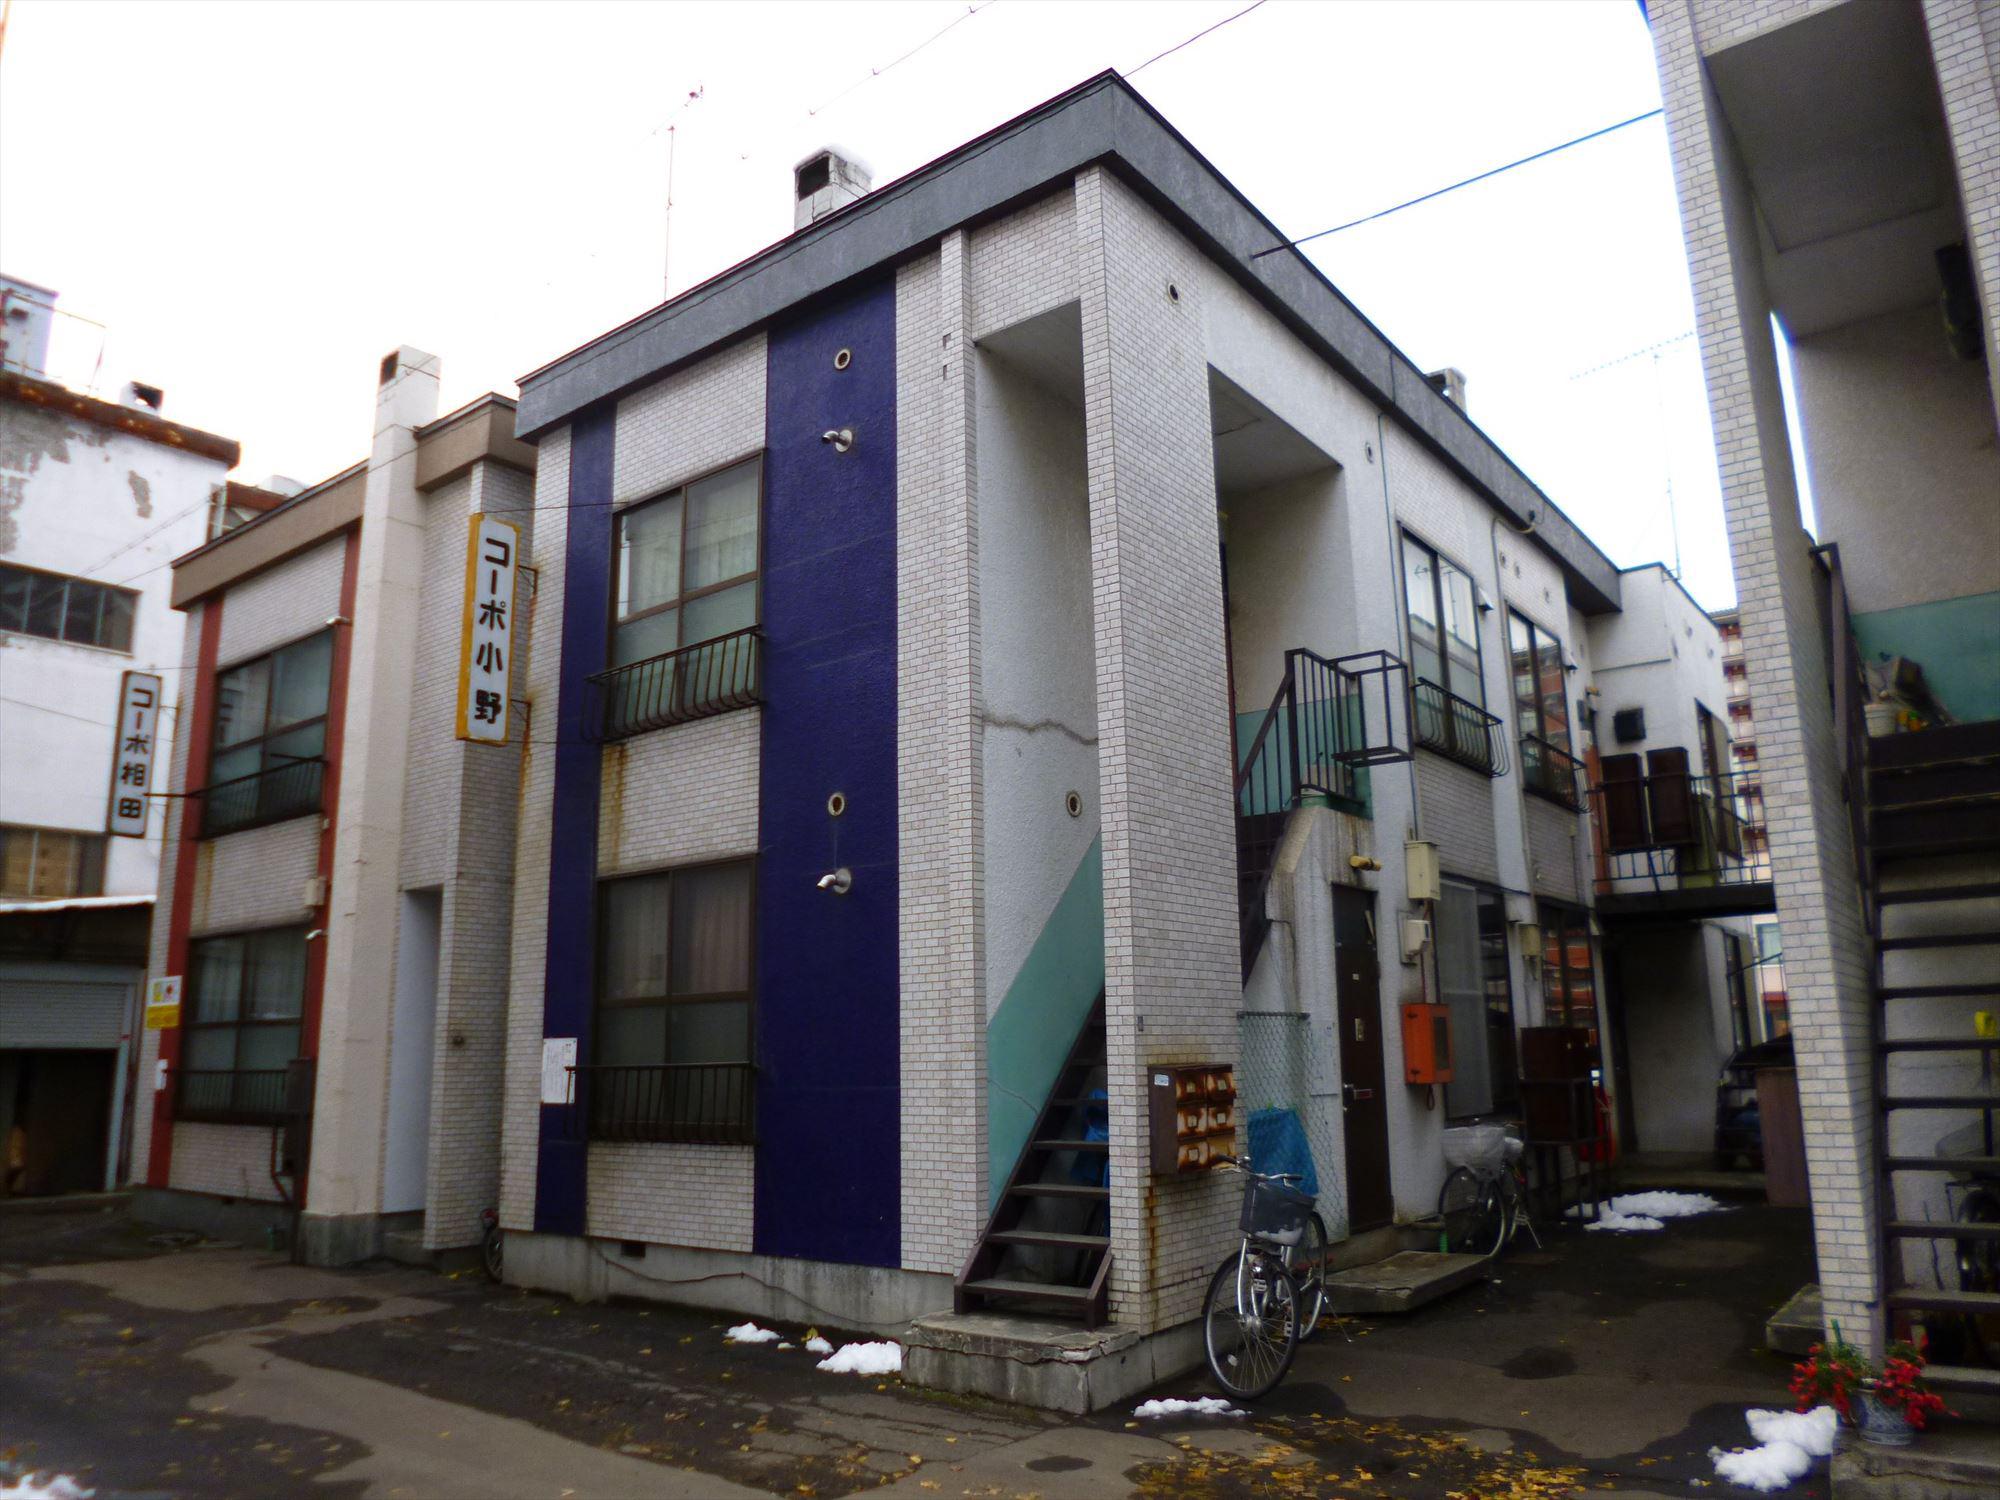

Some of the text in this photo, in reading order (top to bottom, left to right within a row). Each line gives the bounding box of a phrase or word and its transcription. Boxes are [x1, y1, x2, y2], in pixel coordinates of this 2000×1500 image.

[474, 537, 511, 725] コーポ小野
